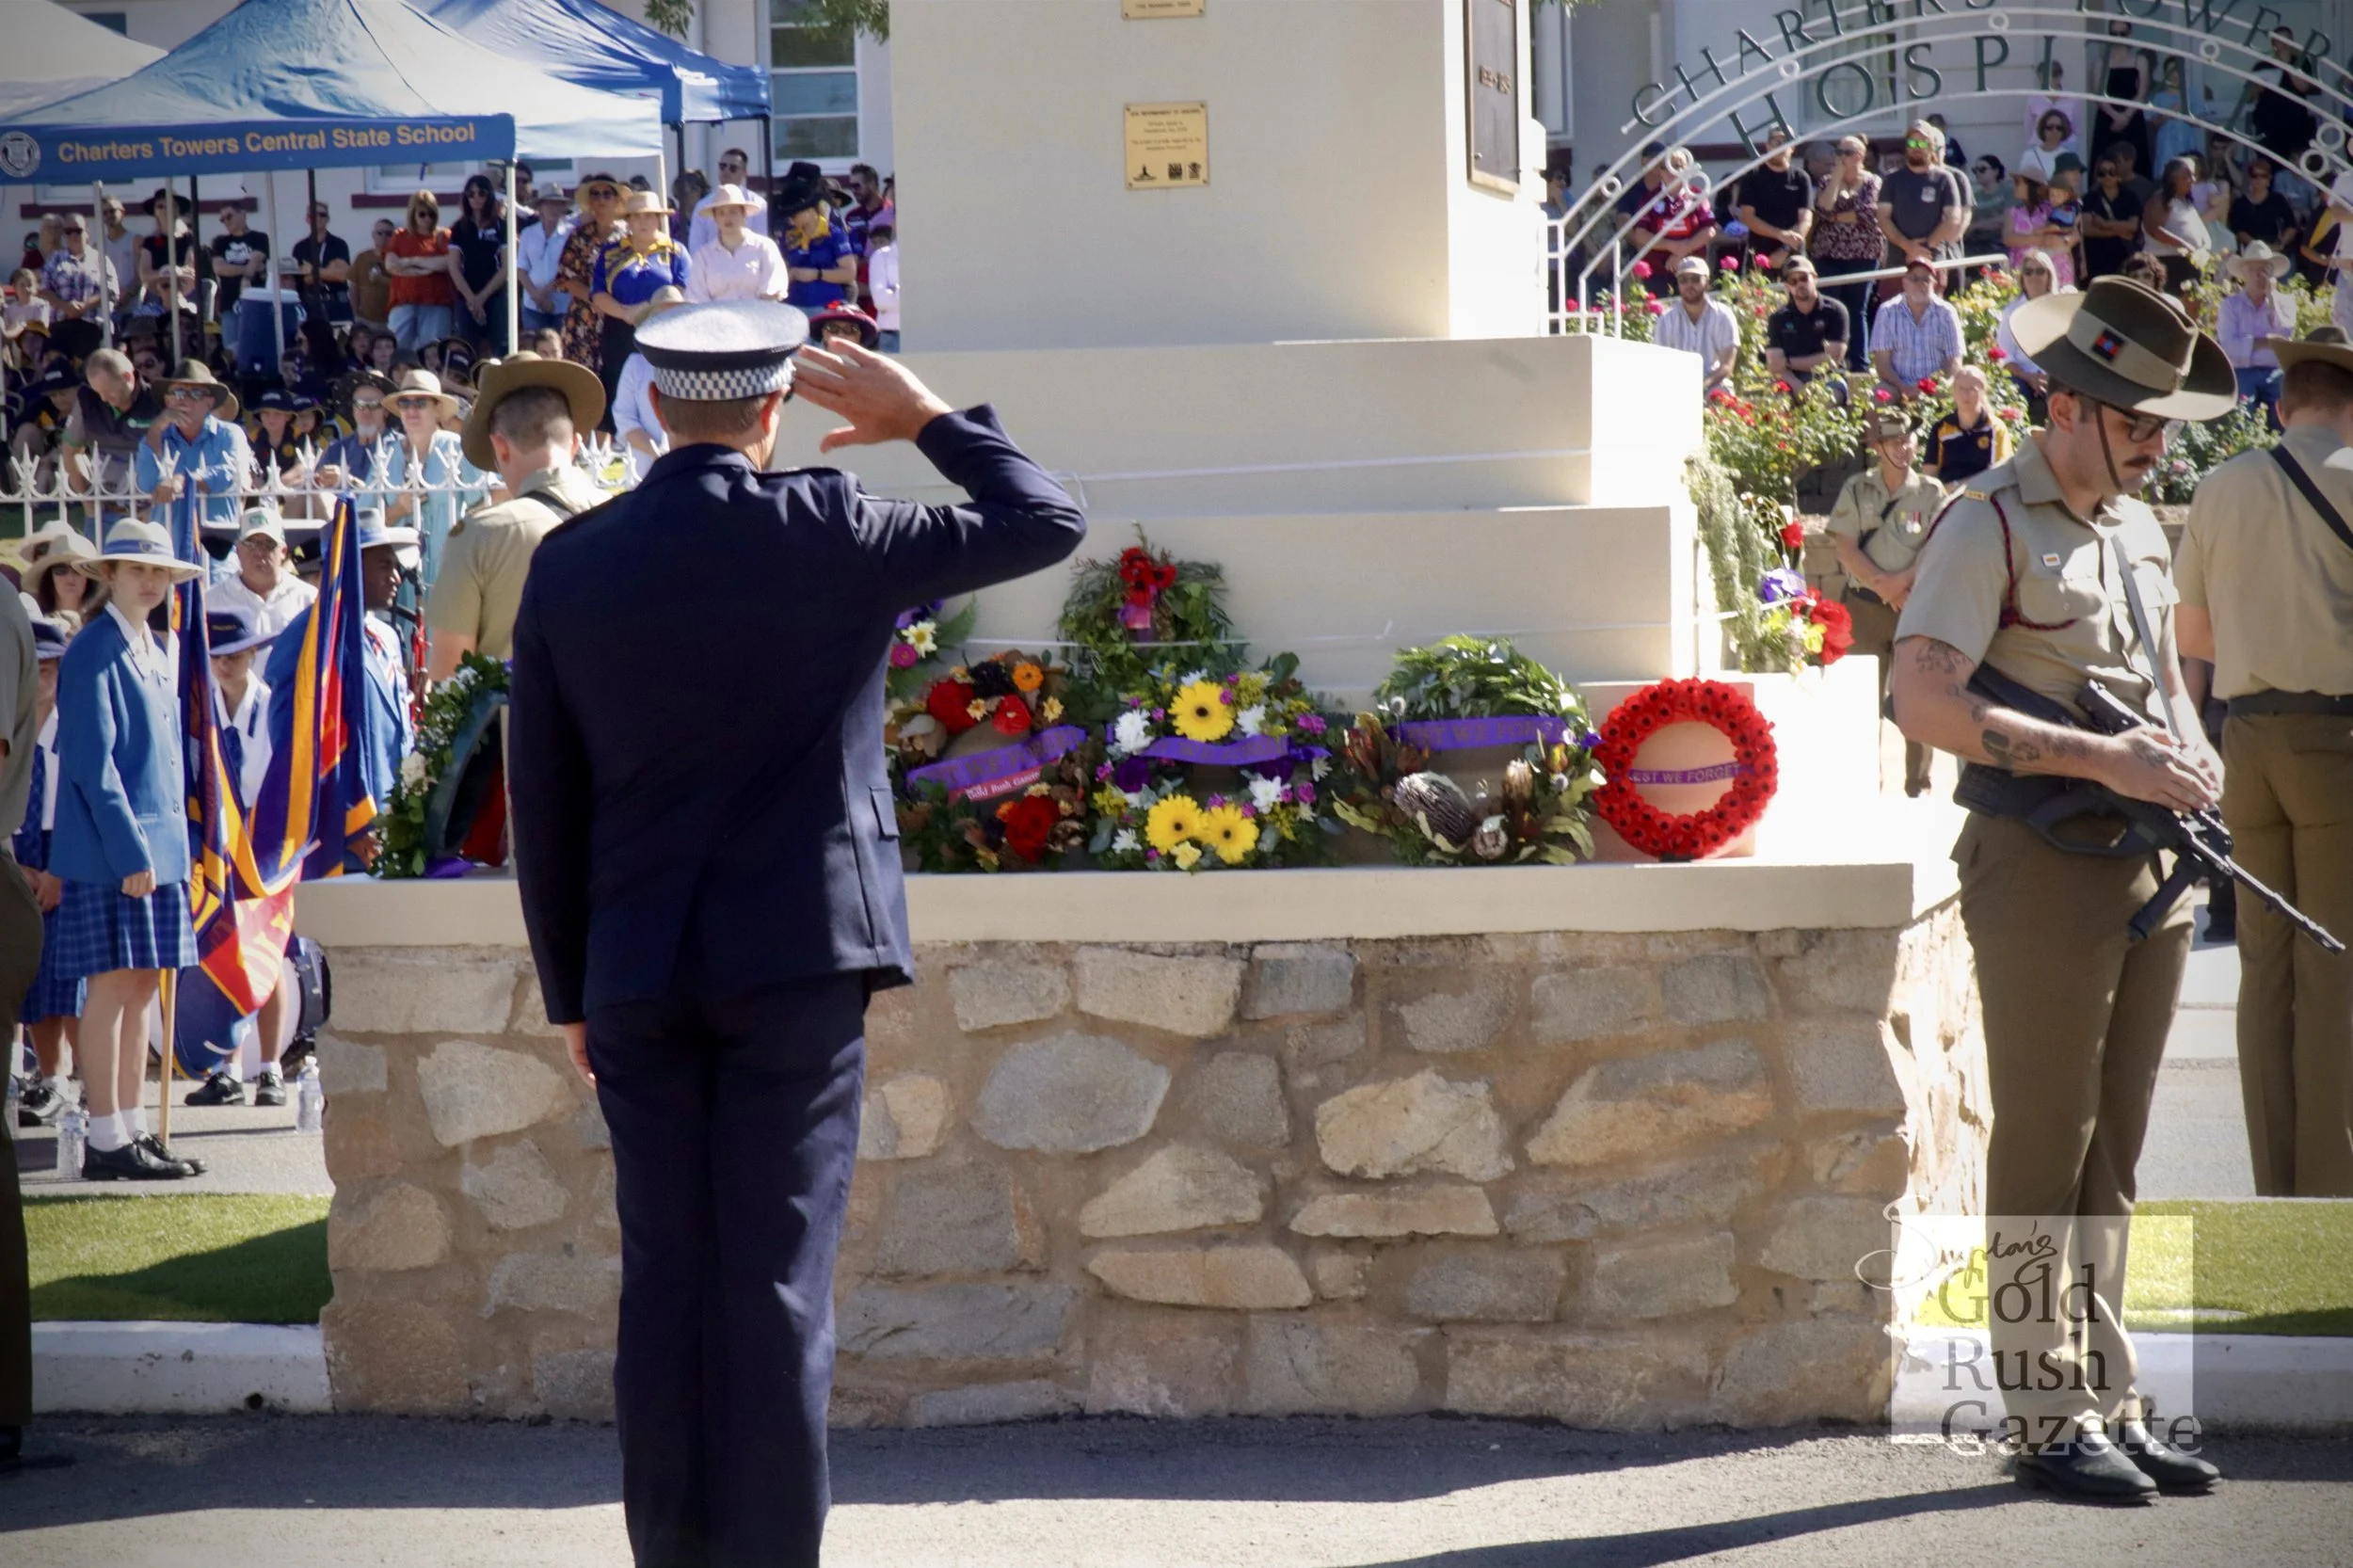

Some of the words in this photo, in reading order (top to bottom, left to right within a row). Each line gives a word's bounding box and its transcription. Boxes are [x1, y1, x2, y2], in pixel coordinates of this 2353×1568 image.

[1632, 0, 1994, 127] CHARTE
[58, 140, 153, 163] Charters
[158, 136, 239, 158] Towers
[245, 128, 326, 152] Central
[331, 127, 391, 150] State
[396, 122, 475, 145] School
[1662, 772, 1684, 783] WE
[1688, 763, 1740, 782] FORGET
